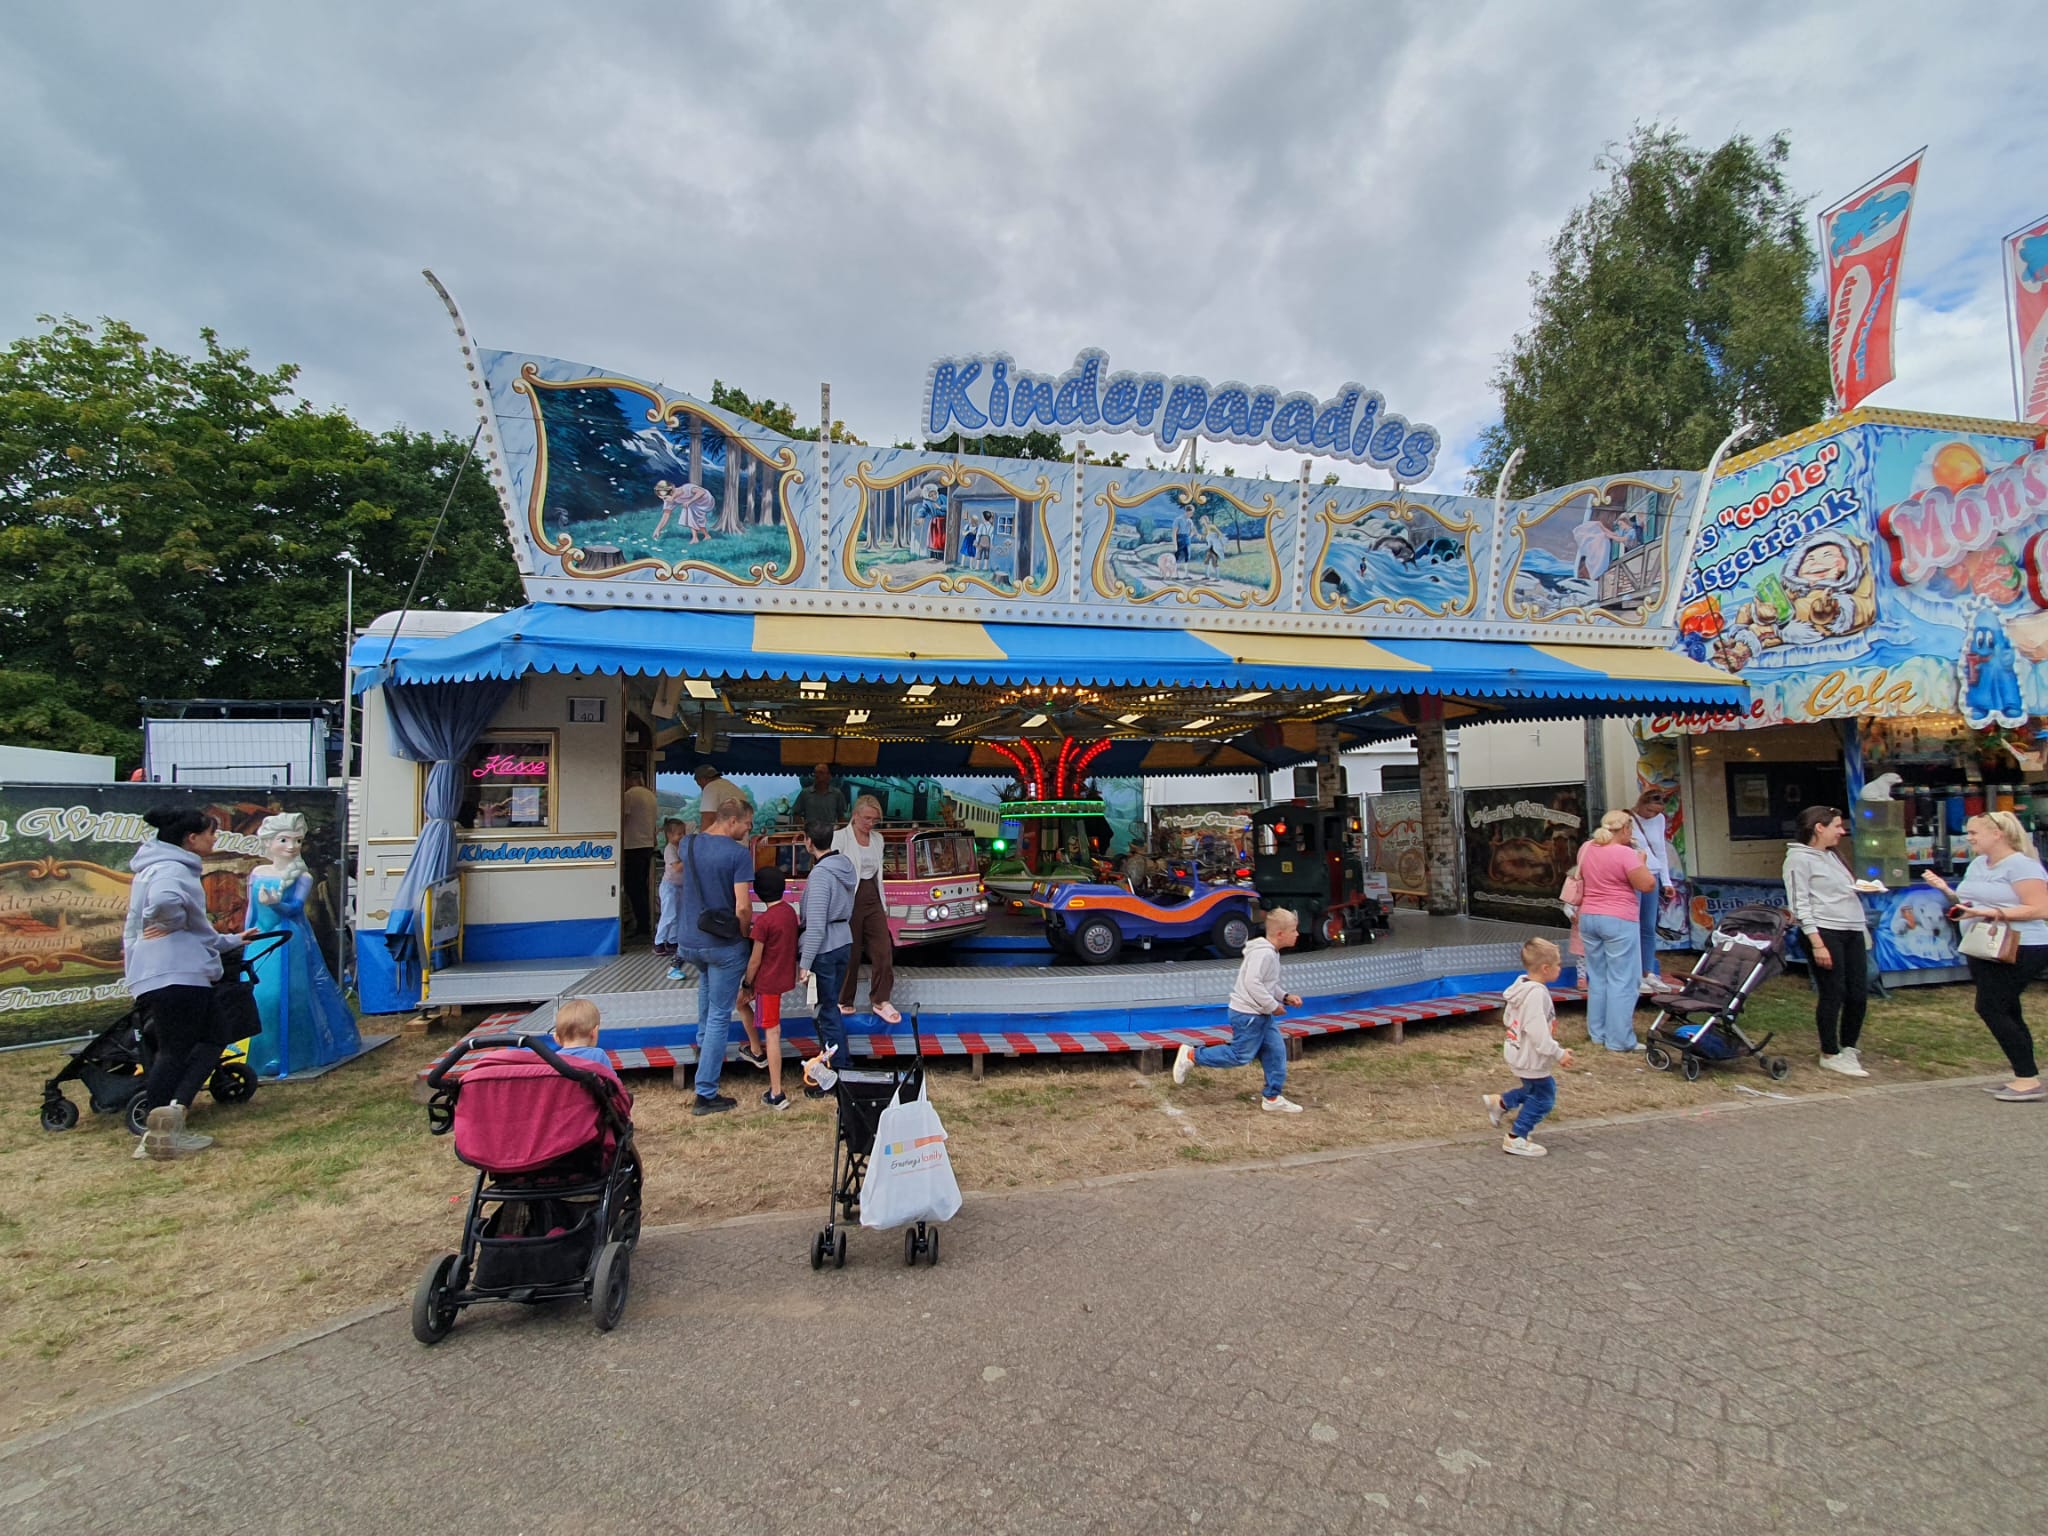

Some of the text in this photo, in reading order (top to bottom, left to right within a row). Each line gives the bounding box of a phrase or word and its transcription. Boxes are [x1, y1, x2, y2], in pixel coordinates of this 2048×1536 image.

[925, 352, 1438, 480] Kinderparadies
[1719, 443, 1838, 527] "coole"
[1805, 670, 1917, 717] Cola
[472, 754, 548, 778] Kasse
[457, 841, 613, 864] Kinderparadies
